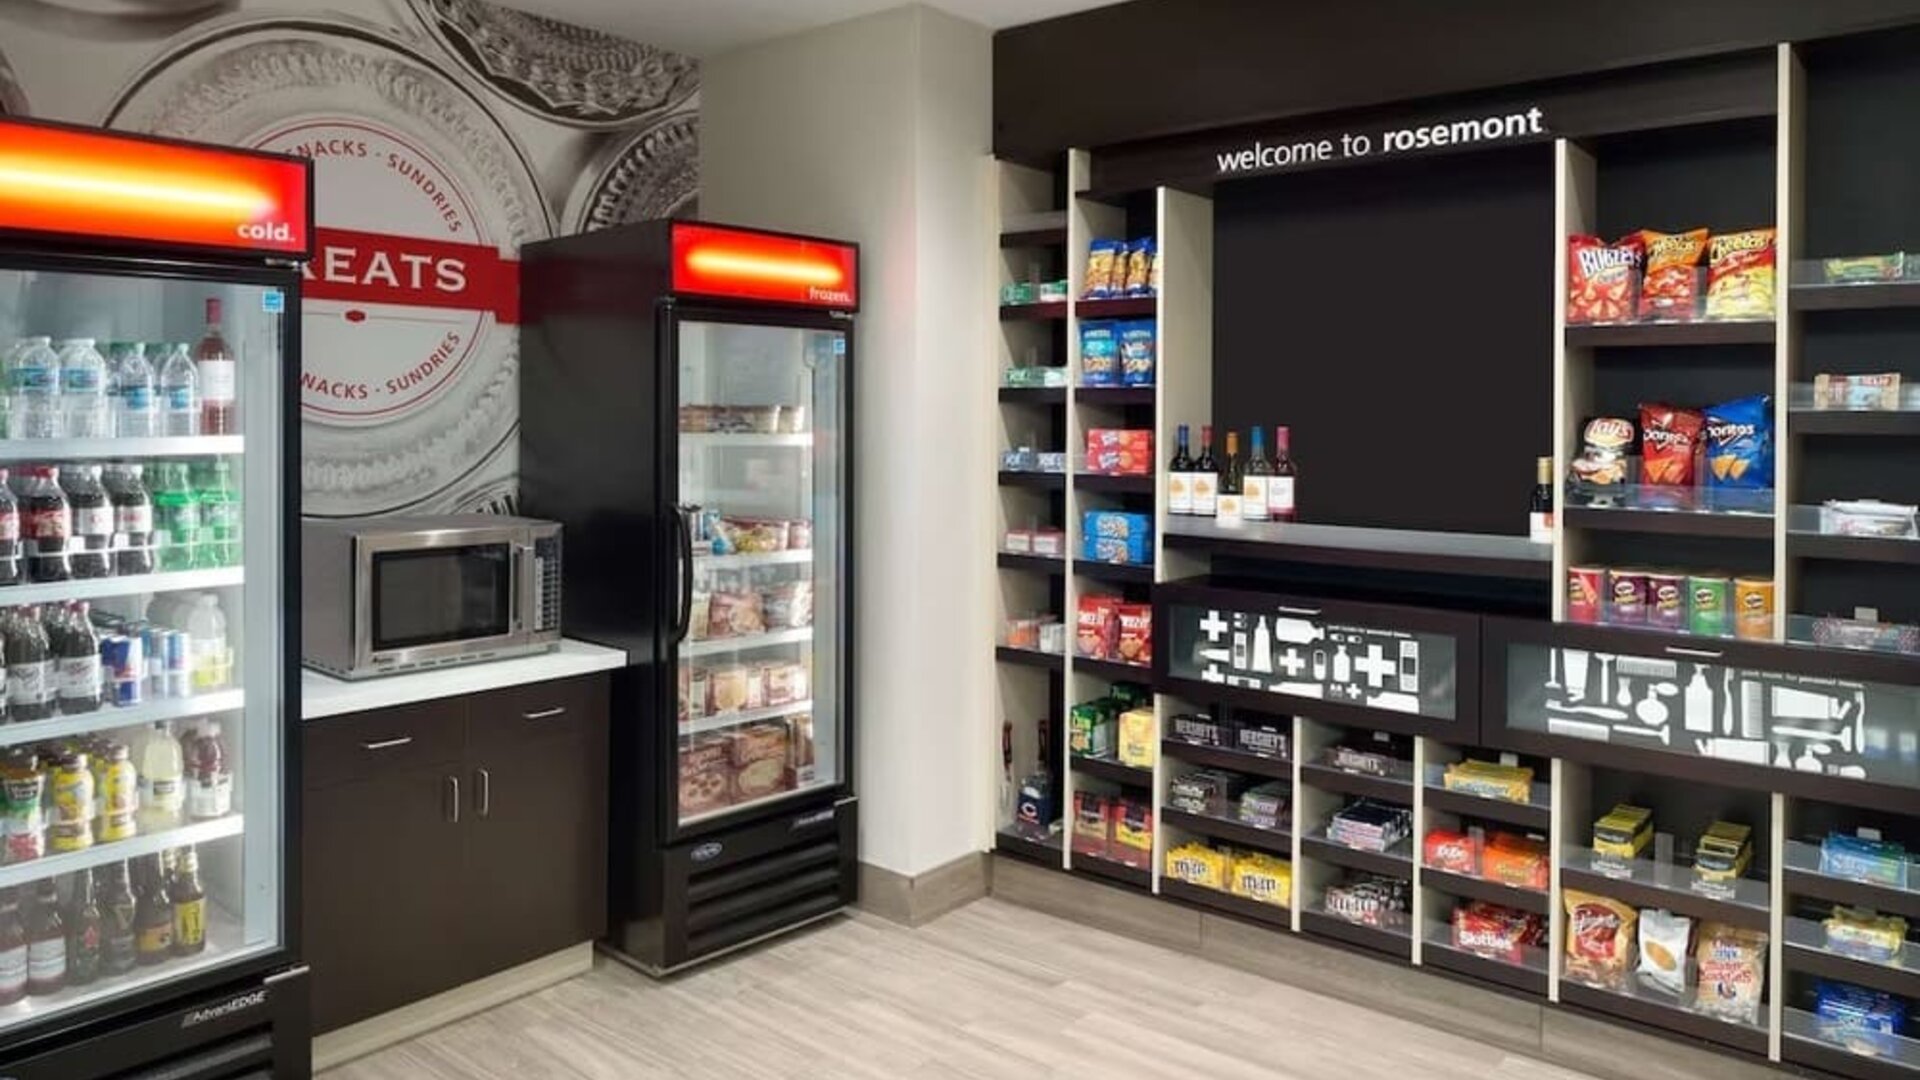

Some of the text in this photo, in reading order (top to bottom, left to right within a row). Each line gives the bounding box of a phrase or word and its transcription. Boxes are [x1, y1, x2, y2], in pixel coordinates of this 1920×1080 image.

[1217, 107, 1543, 172] welcome to rosemont
[386, 152, 463, 233] SUNDRIES
[237, 222, 296, 241] cold.
[301, 331, 461, 399] NACKS SUNDRIES
